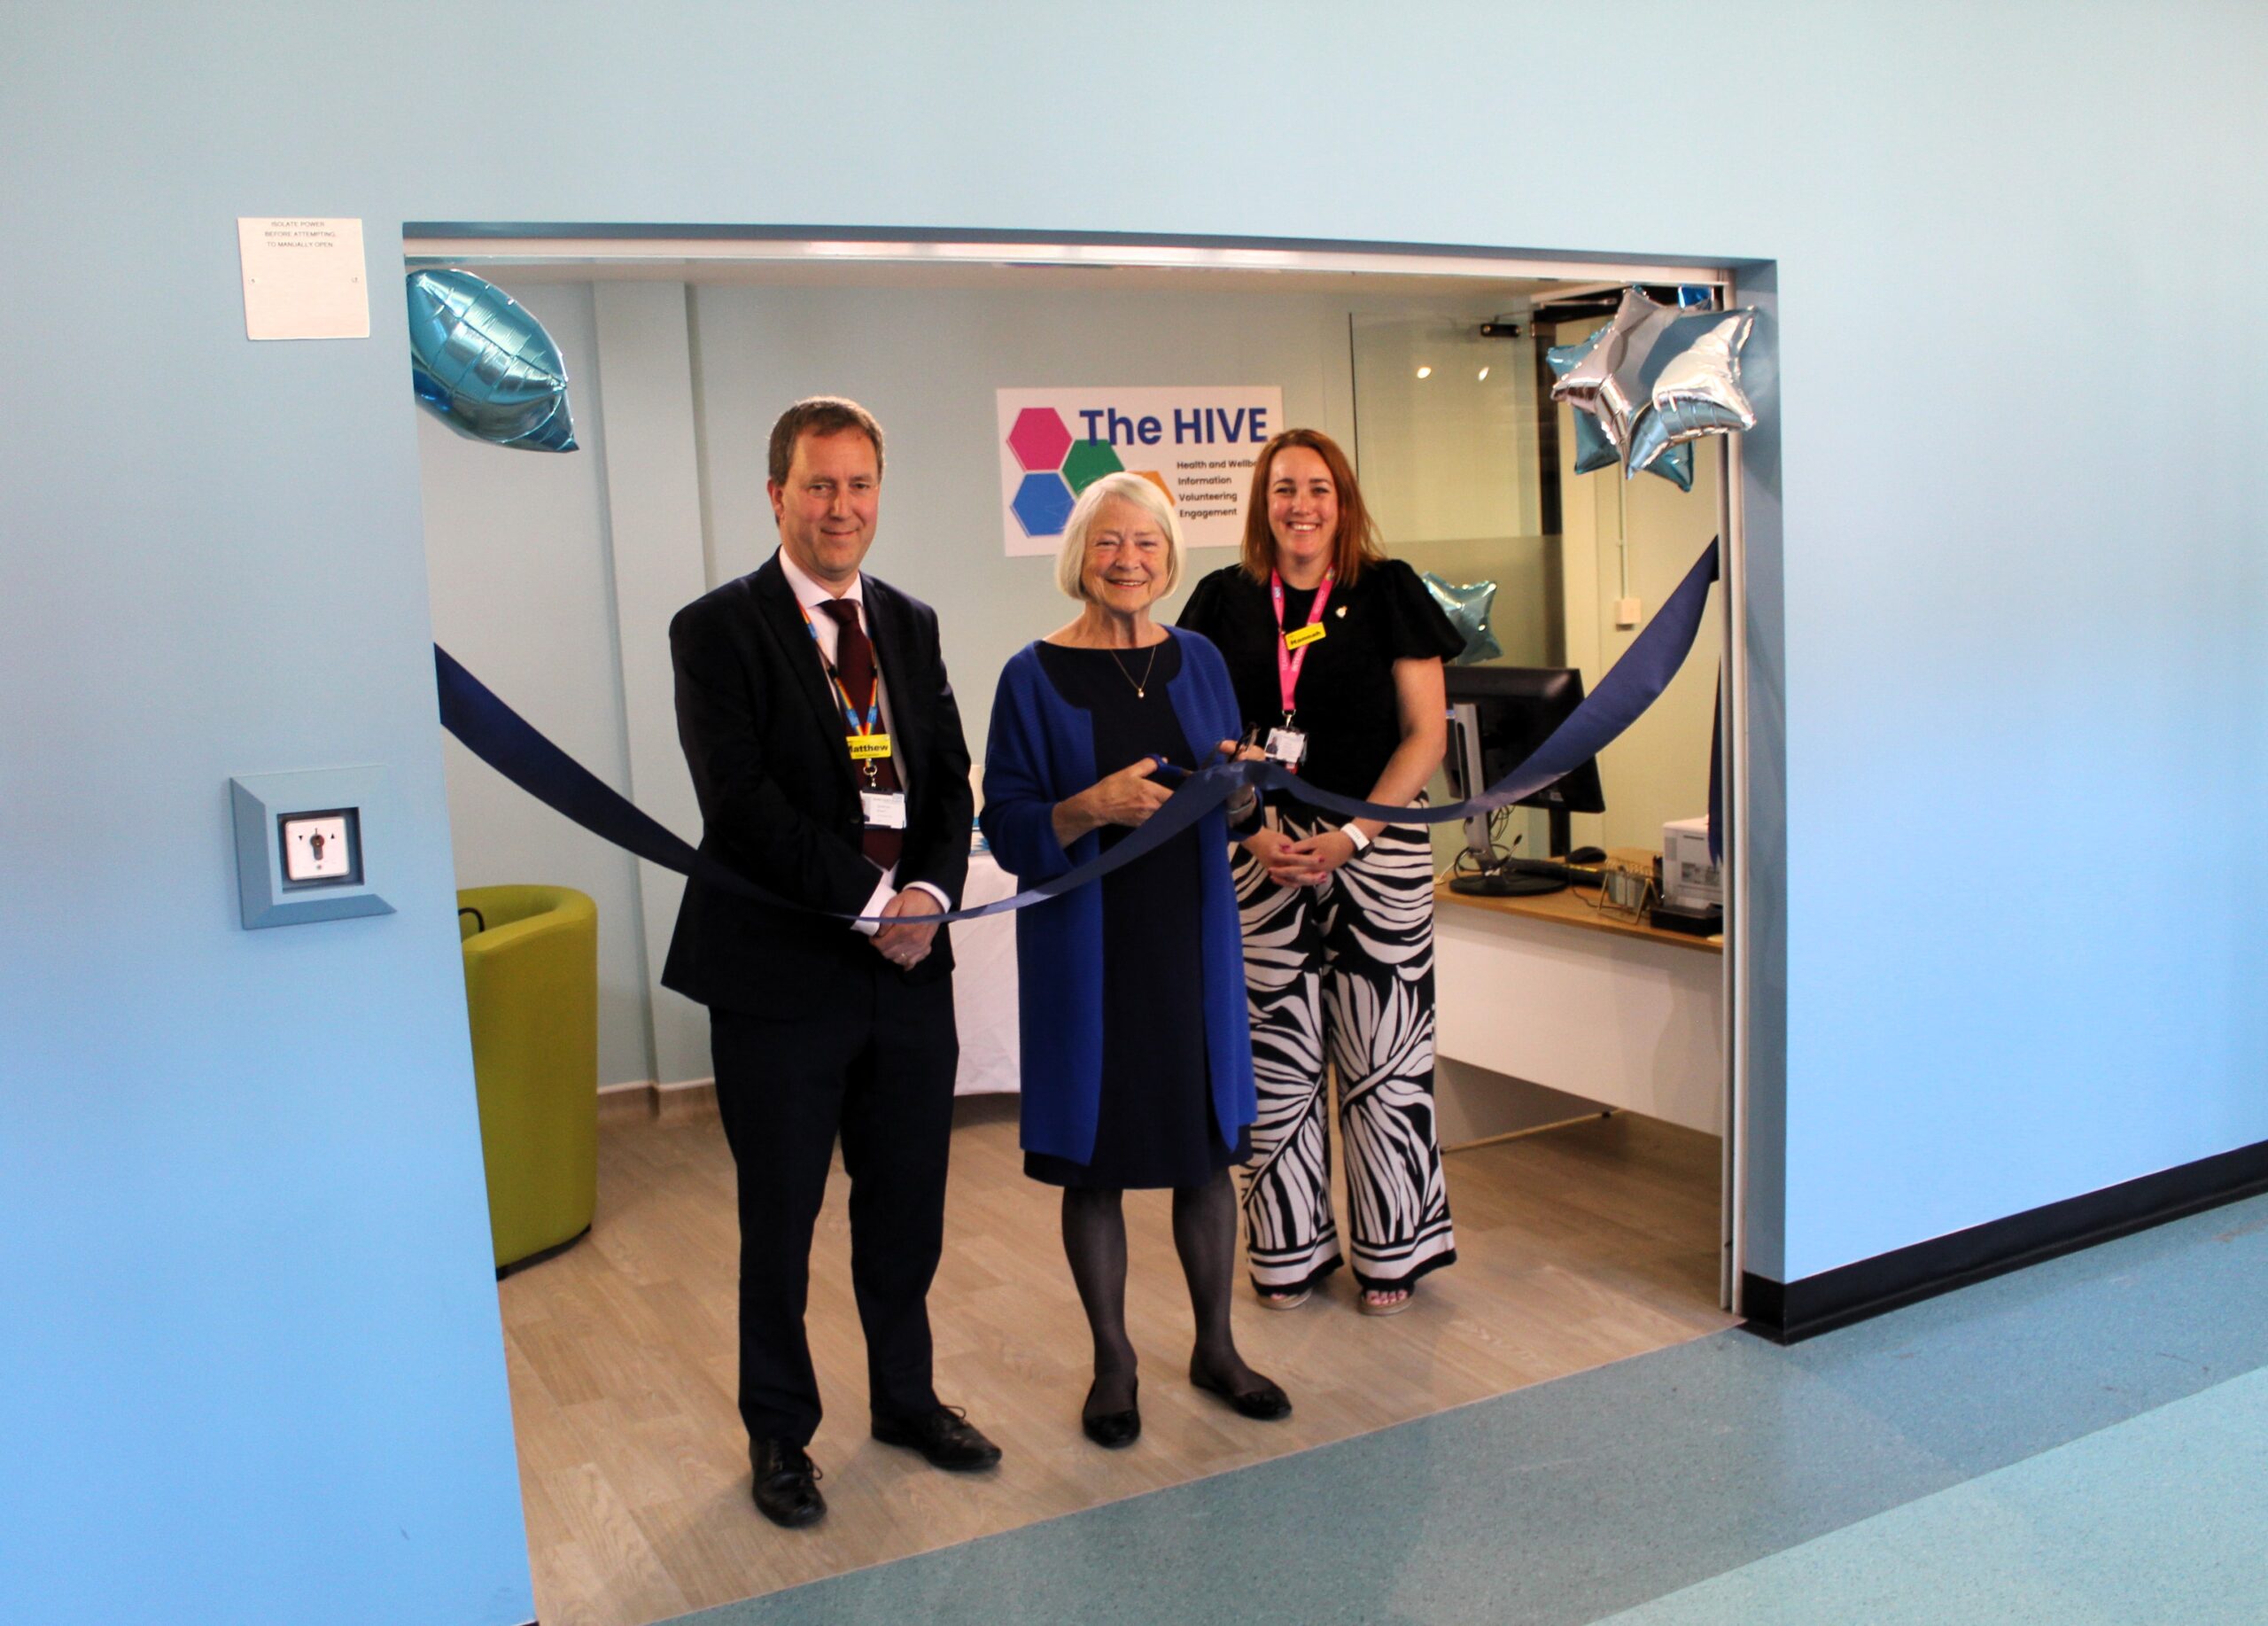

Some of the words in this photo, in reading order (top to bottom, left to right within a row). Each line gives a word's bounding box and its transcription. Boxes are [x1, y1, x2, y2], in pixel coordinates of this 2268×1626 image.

[1079, 408, 1162, 447] The
[1174, 408, 1268, 444] HIVE
[1177, 461, 1207, 470] Health
[1208, 460, 1226, 469] and
[1177, 476, 1231, 486] Information
[1178, 491, 1238, 502] Volunteering
[1179, 508, 1237, 519] Engagement
